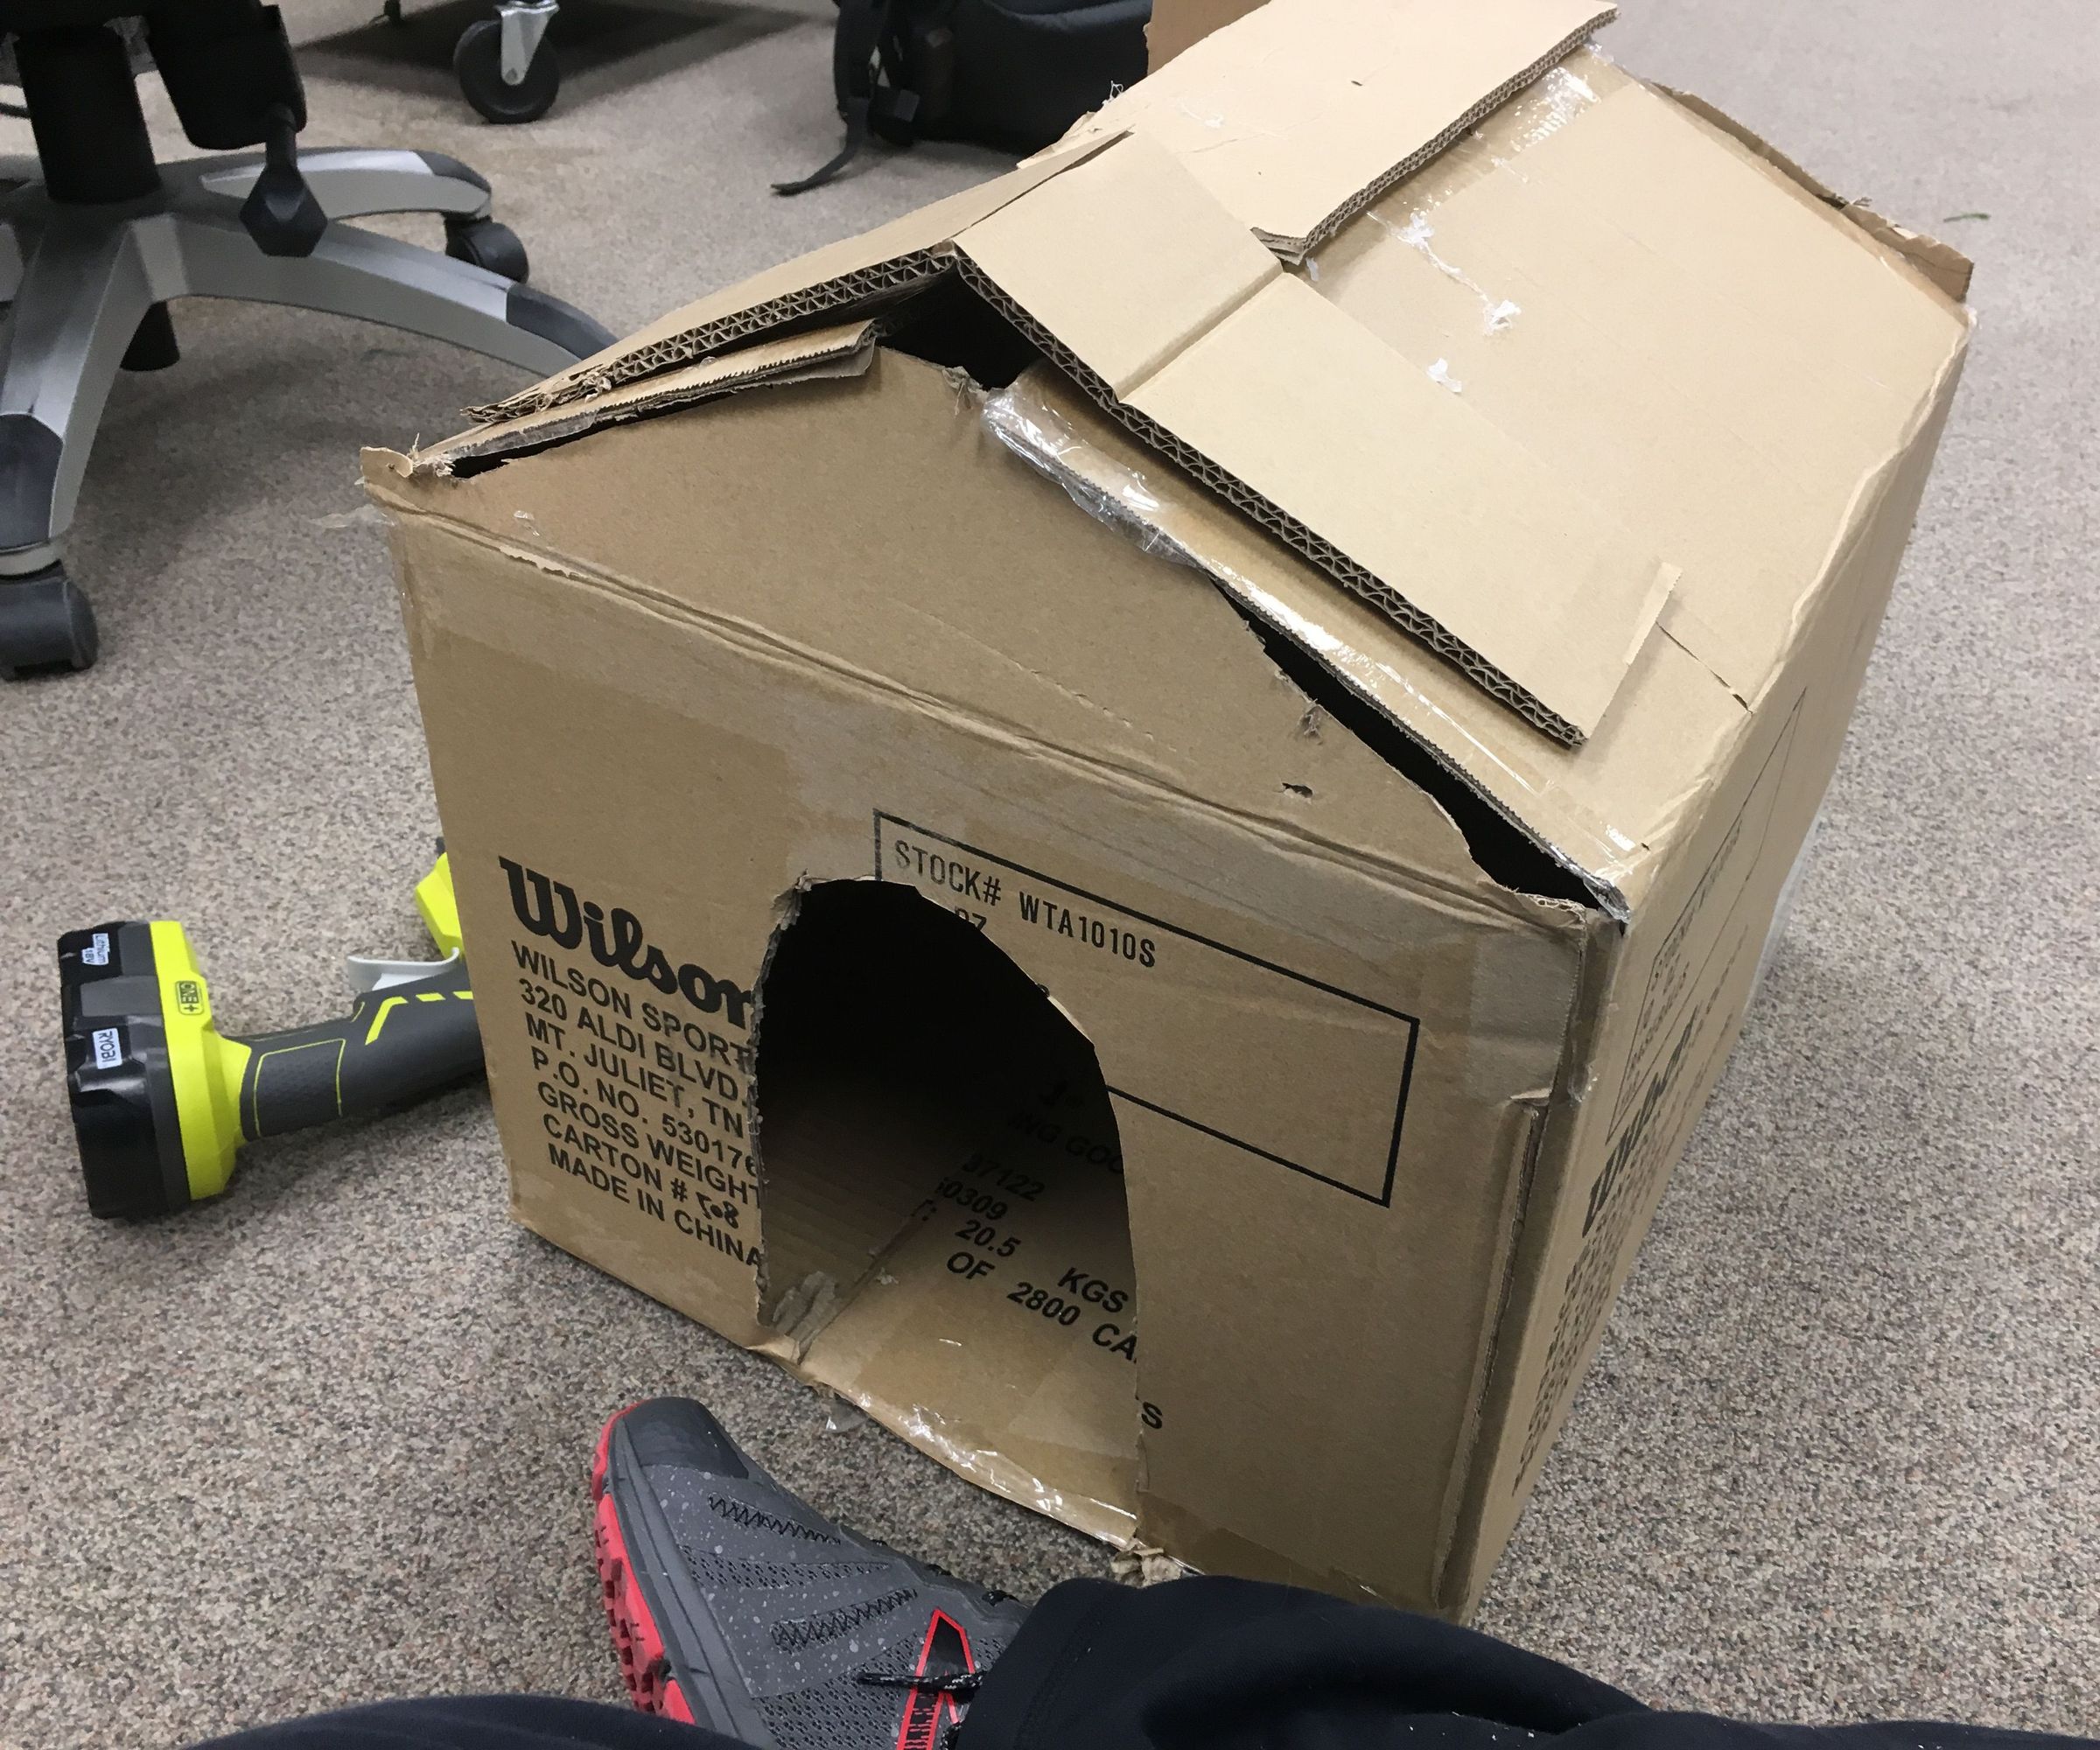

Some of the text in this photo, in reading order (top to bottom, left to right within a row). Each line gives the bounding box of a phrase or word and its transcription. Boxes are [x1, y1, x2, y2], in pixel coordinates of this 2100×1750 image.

[893, 840, 1156, 968] STOCK# WTA1010S
[511, 940, 632, 1019] WILSON
[97, 1030, 116, 1063] RYOBI
[521, 978, 747, 1107] 320 ALDI BLVD.
[530, 1046, 588, 1094] P.O.
[598, 1079, 648, 1124] NO.
[584, 1043, 695, 1119] JULIET,
[702, 1096, 743, 1138] TN
[537, 1081, 760, 1209] GROSS WEIGHT
[543, 1113, 662, 1192] CARTON
[962, 1152, 1046, 1202] 37122
[547, 1142, 762, 1266] MADE IN CHINA
[946, 1250, 1138, 1364] OF 2800 CA
[955, 1219, 1130, 1314] 20.5 KGS
